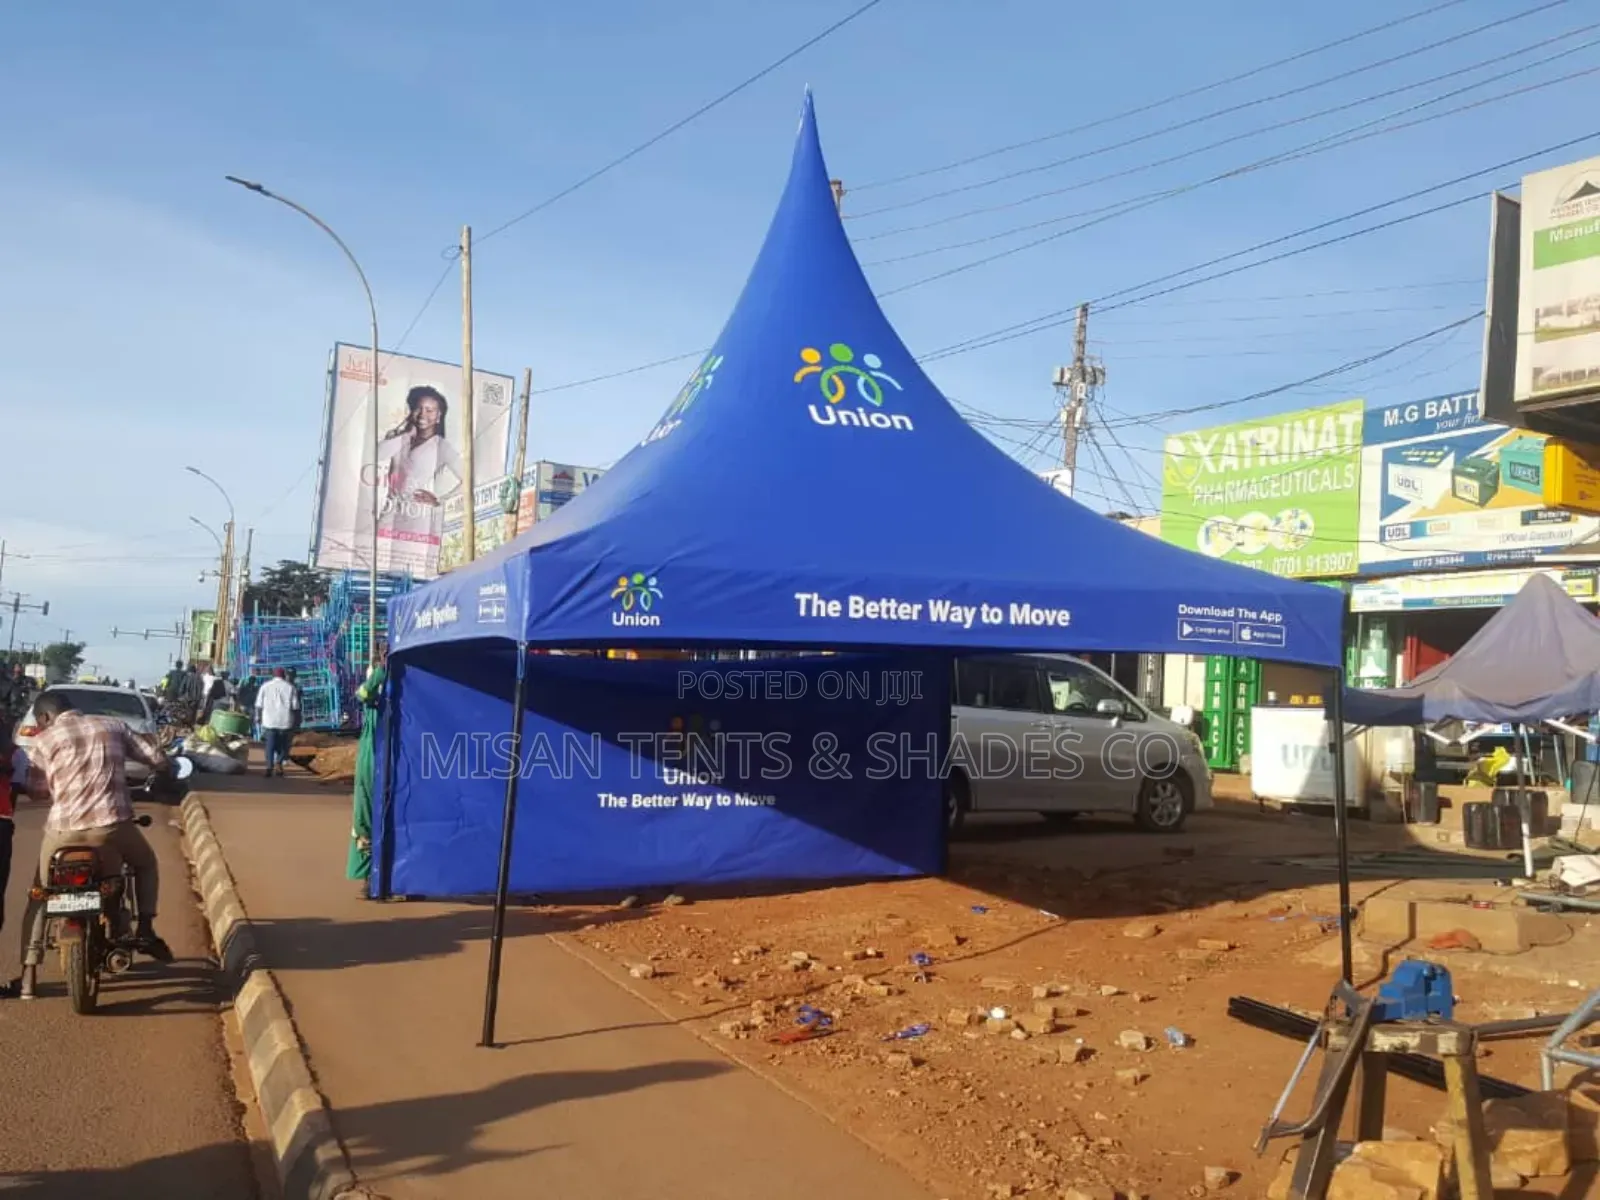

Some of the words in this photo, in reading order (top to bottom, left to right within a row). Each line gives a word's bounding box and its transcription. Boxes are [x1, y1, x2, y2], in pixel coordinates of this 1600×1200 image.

[808, 404, 914, 431] Union
[1384, 405, 1419, 427] M.G
[1193, 462, 1356, 506] PHARMACEUTICALS
[1387, 527, 1408, 537] UDL
[612, 611, 660, 626] Union
[795, 592, 842, 617] The
[848, 595, 922, 621] Better
[927, 599, 976, 629] Way
[981, 603, 1003, 624] to
[1009, 603, 1071, 626] Move
[1178, 604, 1235, 618] Download
[1237, 607, 1258, 619] The
[1259, 609, 1283, 623] App
[1235, 660, 1248, 756] ARMACY
[663, 768, 723, 785] Union
[597, 793, 627, 808] The
[631, 793, 679, 808] Better
[682, 793, 713, 810] Way
[716, 793, 731, 807] to
[735, 793, 776, 807] Move
